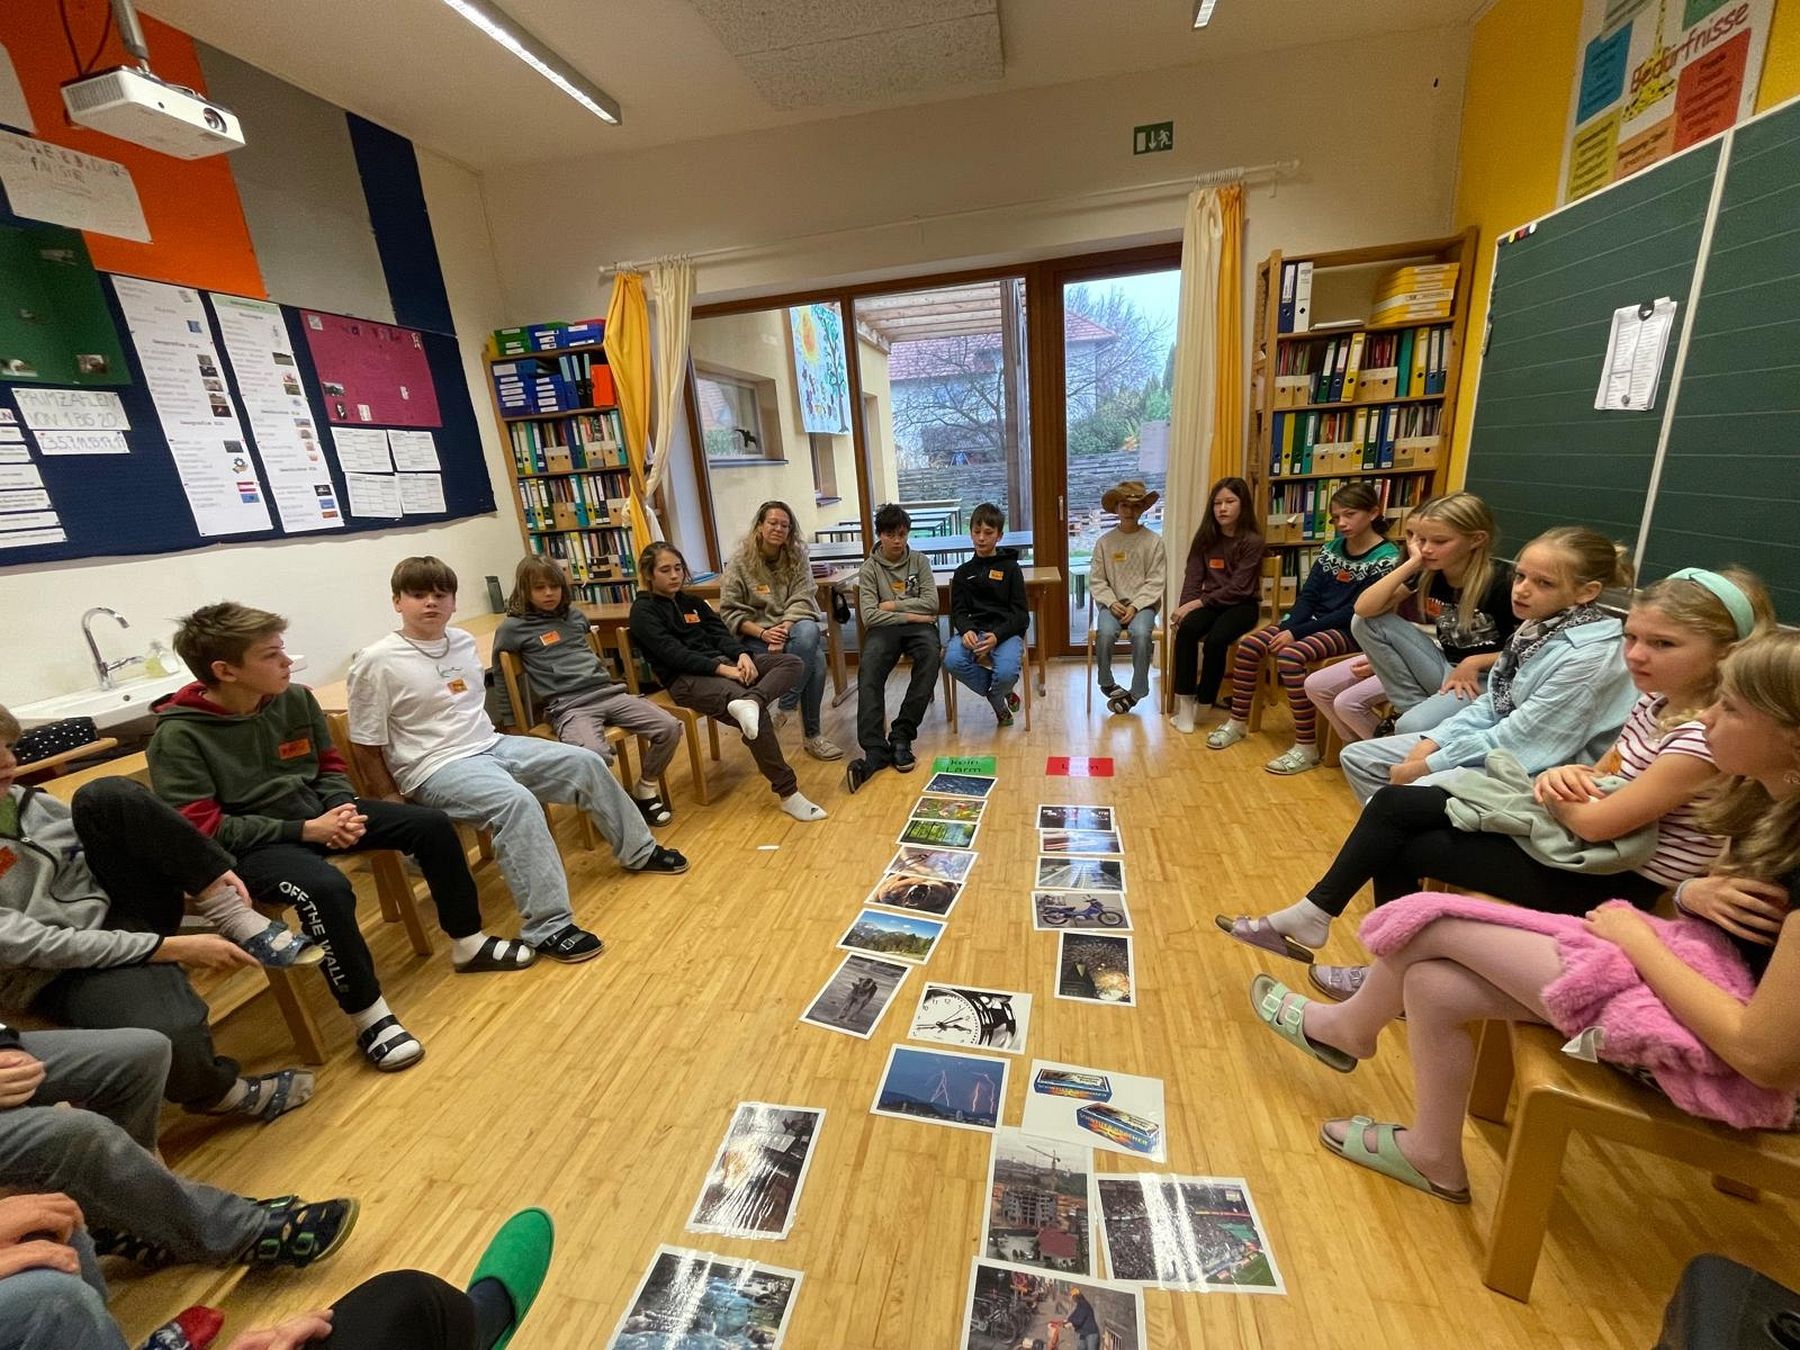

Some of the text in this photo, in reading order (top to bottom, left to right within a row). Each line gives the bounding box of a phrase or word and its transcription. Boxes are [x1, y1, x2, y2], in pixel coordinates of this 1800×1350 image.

[278, 881, 346, 986] OFF THE WALL
